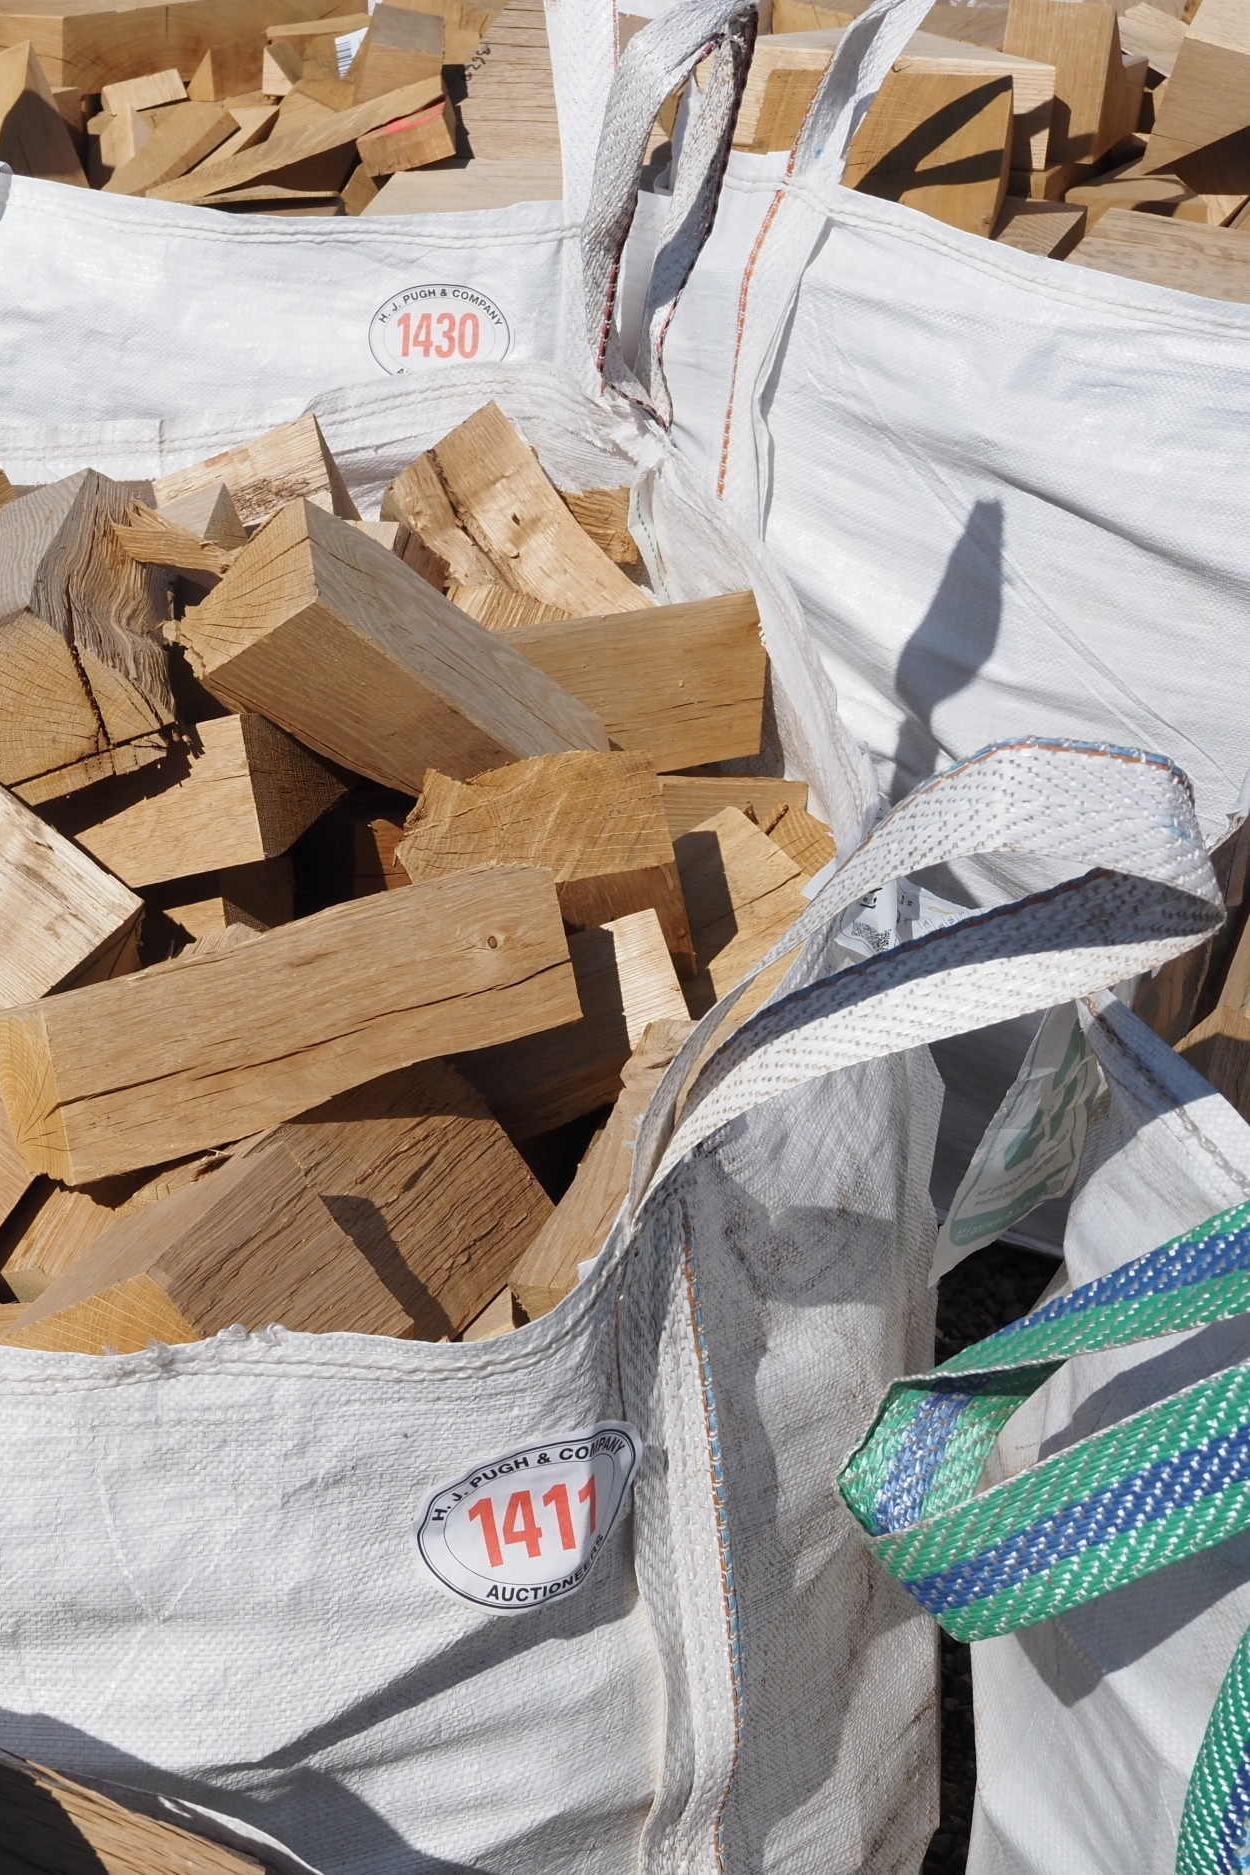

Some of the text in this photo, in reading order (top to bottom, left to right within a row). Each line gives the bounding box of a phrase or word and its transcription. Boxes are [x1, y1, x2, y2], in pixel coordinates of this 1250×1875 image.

[378, 288, 503, 326] H. J. PUGH & COMPANY
[397, 312, 480, 359] 1430
[431, 1436, 626, 1522] H. J. PUGH & COMPANY
[467, 1473, 597, 1568] 1411
[485, 1533, 604, 1601] AUCTIONEERS
